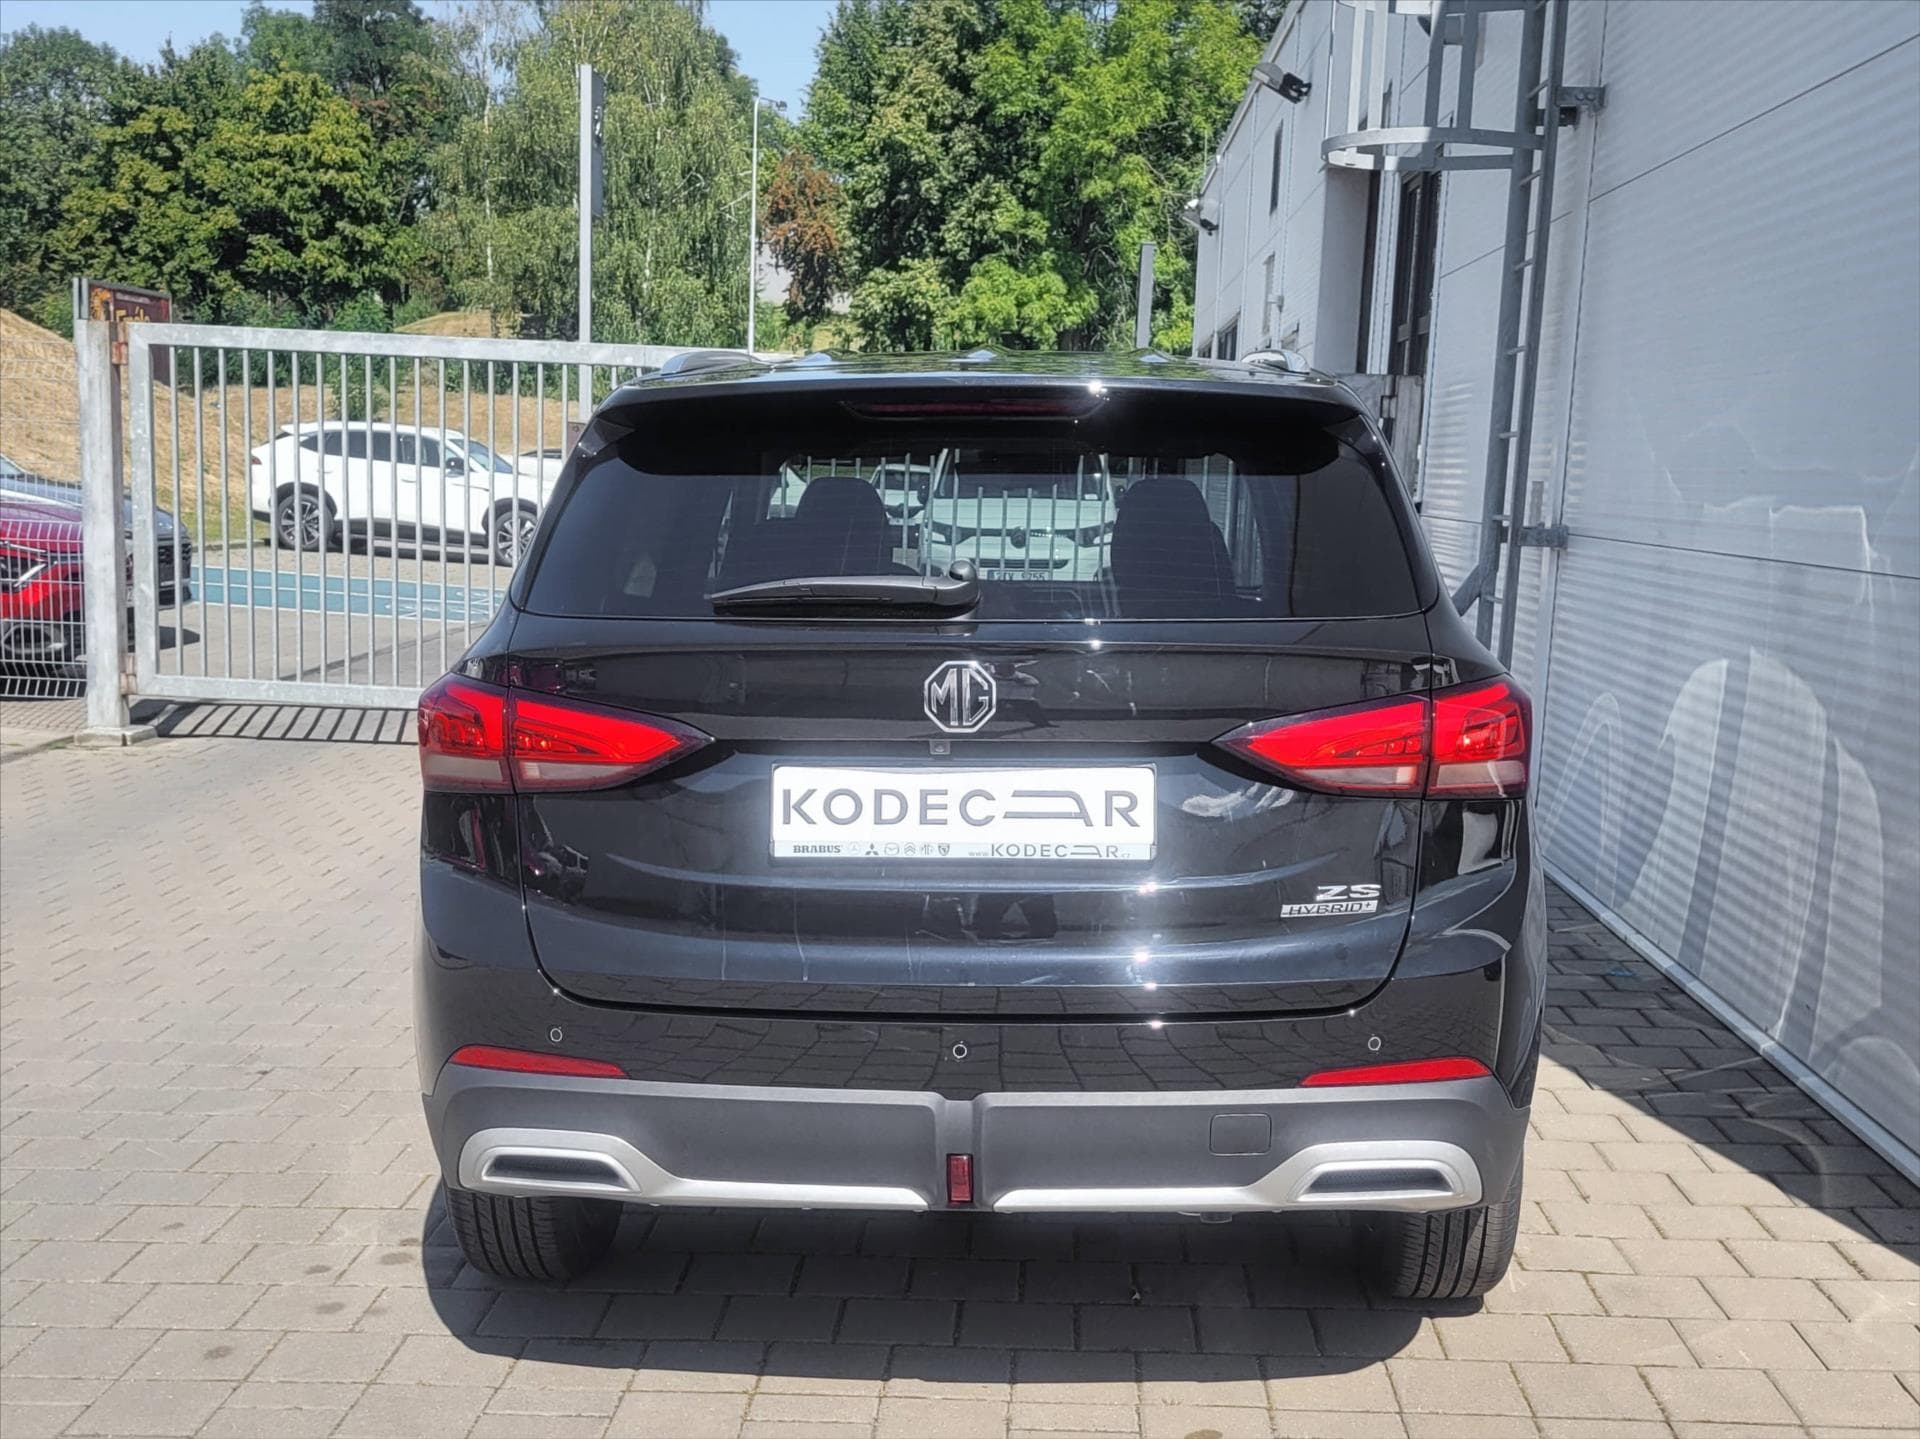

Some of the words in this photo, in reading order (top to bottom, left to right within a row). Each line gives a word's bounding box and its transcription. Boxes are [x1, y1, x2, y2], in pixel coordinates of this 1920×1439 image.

[930, 668, 989, 726] MG
[782, 788, 1140, 827] KODECAR
[793, 845, 841, 854] BRABUS
[1315, 884, 1382, 901] ZS
